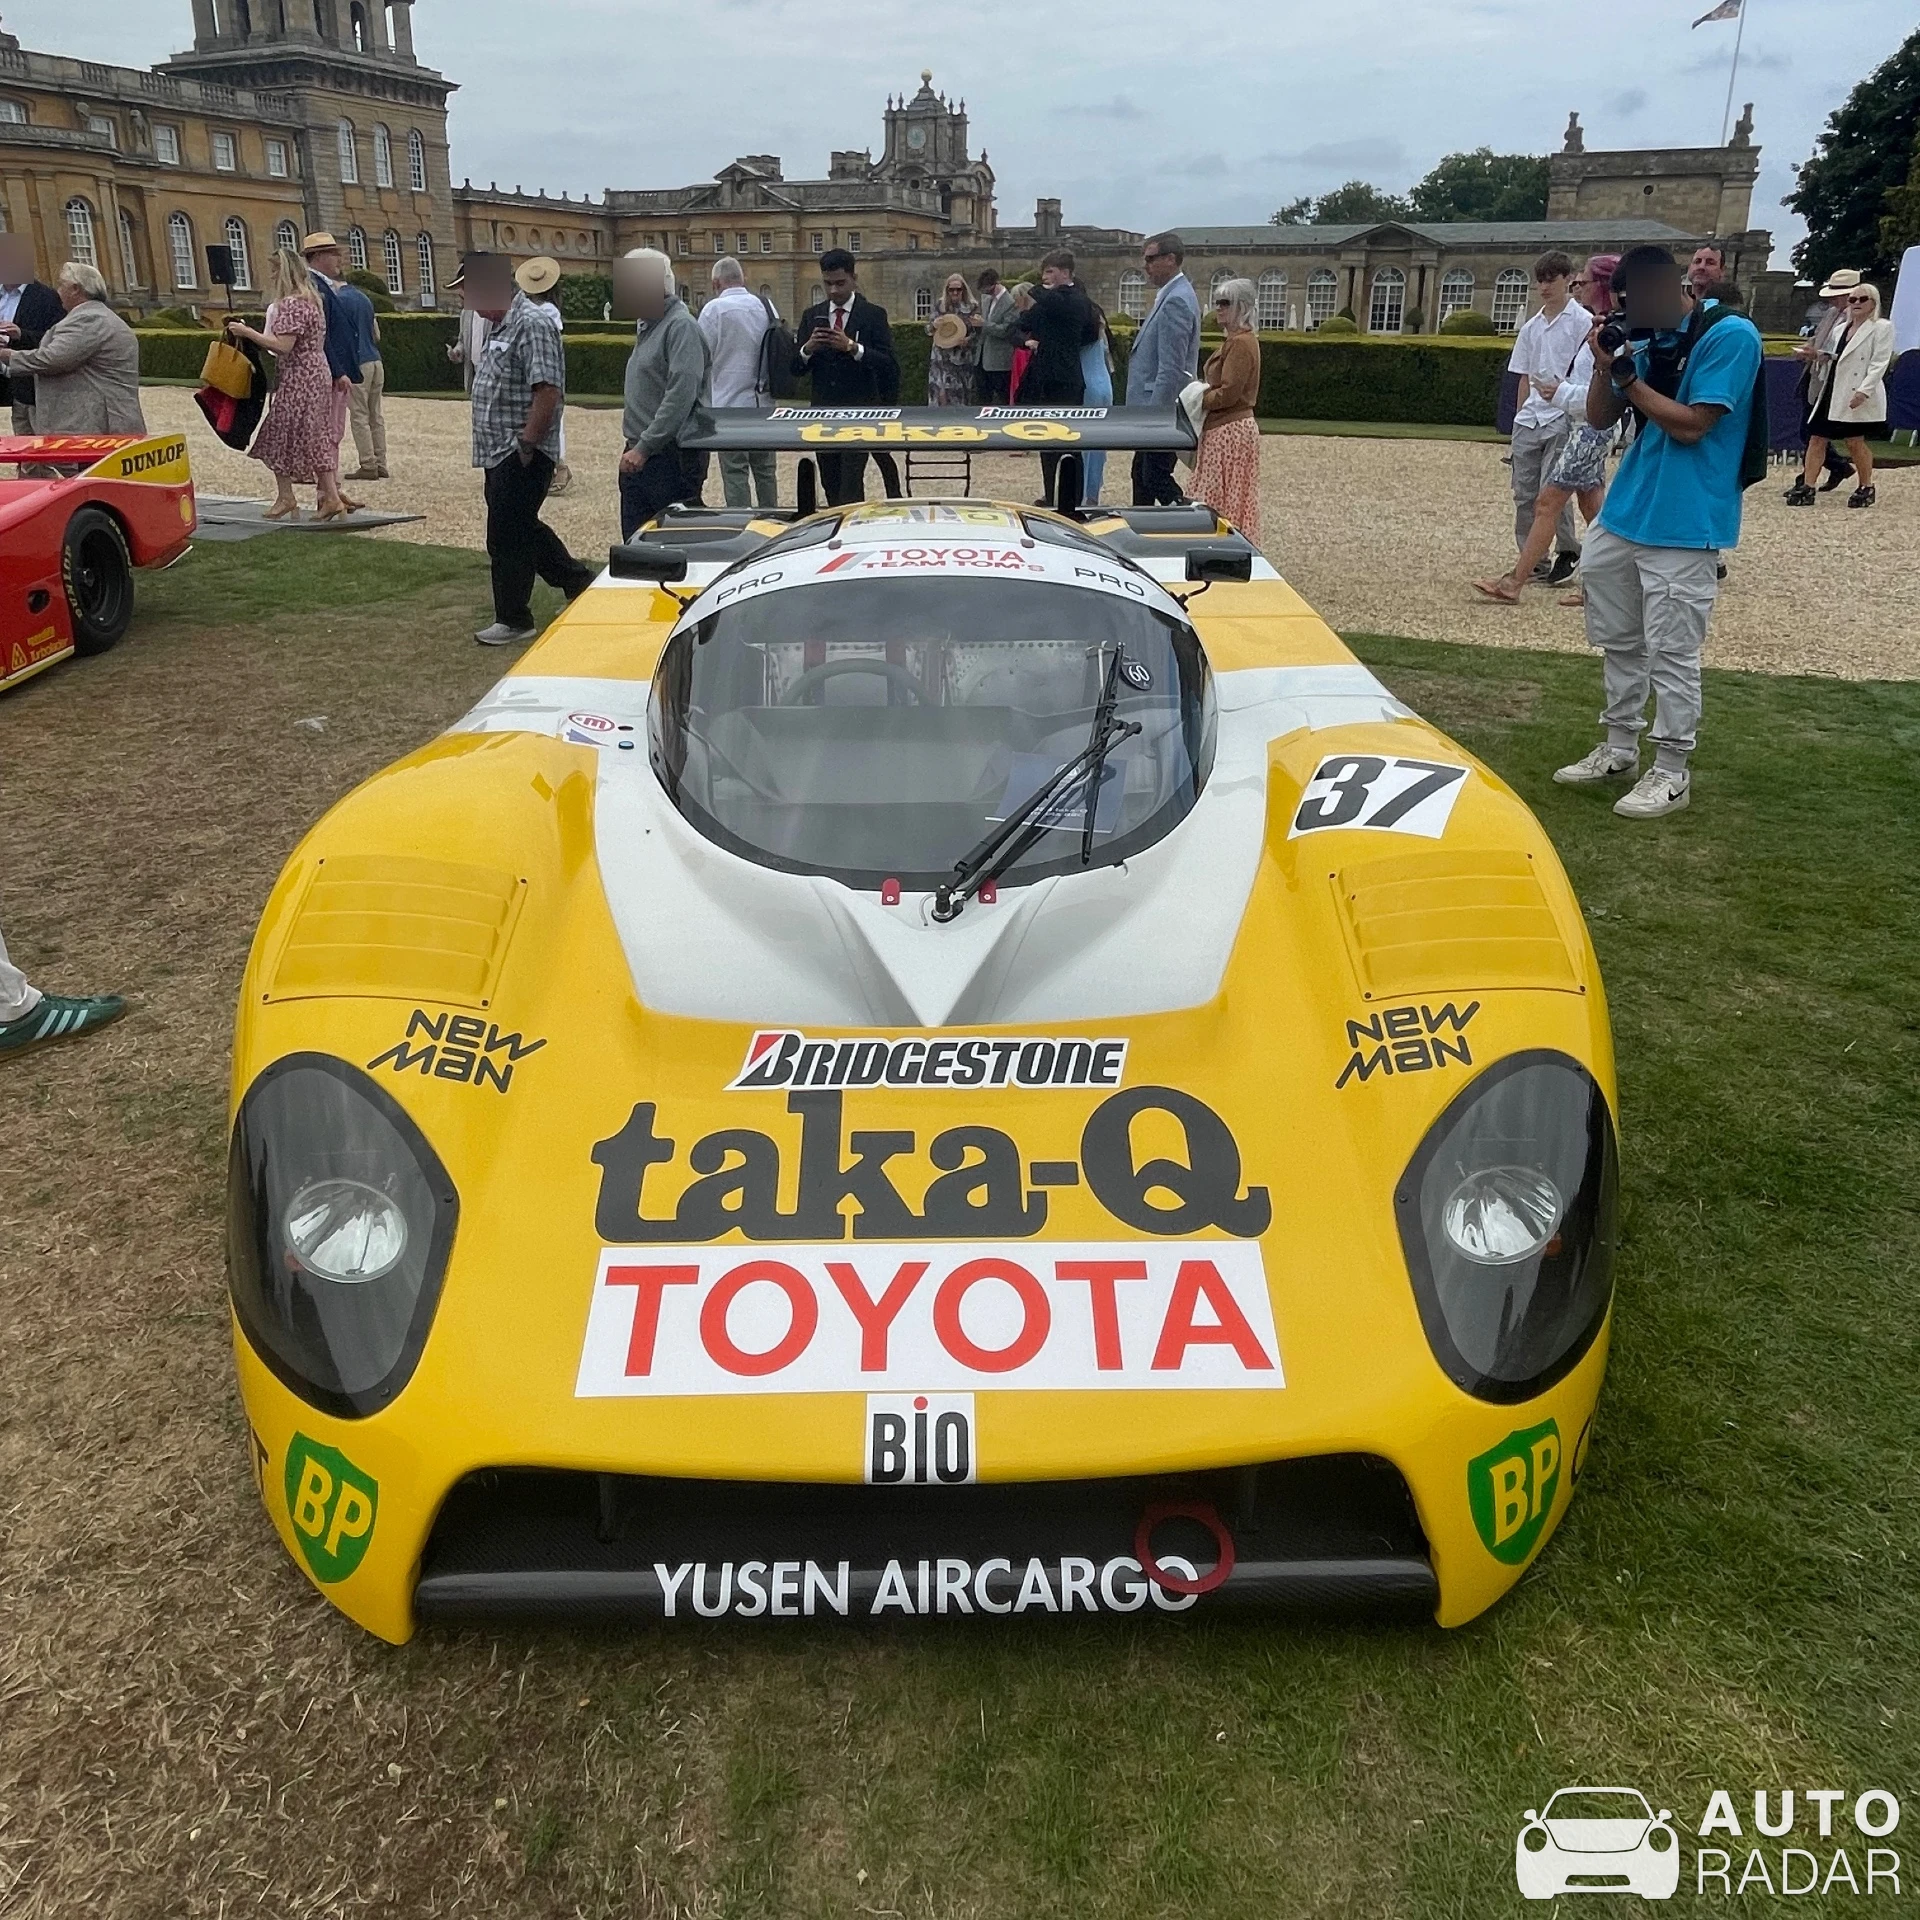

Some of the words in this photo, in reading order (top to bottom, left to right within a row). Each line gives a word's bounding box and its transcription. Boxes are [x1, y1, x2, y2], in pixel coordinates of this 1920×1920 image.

[769, 407, 901, 420] BRIDGESTONE
[977, 407, 1107, 419] BRIDGESTONE
[797, 421, 1082, 443] taka-Q
[121, 442, 186, 477] DUNLOP
[862, 560, 947, 569] TEAM
[955, 560, 1045, 573] TOM'S
[880, 549, 1026, 563] TOYOTA
[716, 572, 784, 605] PRO
[1074, 567, 1145, 597] PRO
[1128, 665, 1150, 682] 60
[1295, 756, 1466, 831] 37
[731, 1031, 1126, 1087] BRIDGESTONE
[590, 1085, 1272, 1243] taka-Q
[604, 1258, 1275, 1378] TOYOTA
[292, 1454, 373, 1558] BP
[1488, 1433, 1561, 1548] BP
[653, 1560, 850, 1617] YUSEN
[869, 1555, 1199, 1614] AIRCARGO
